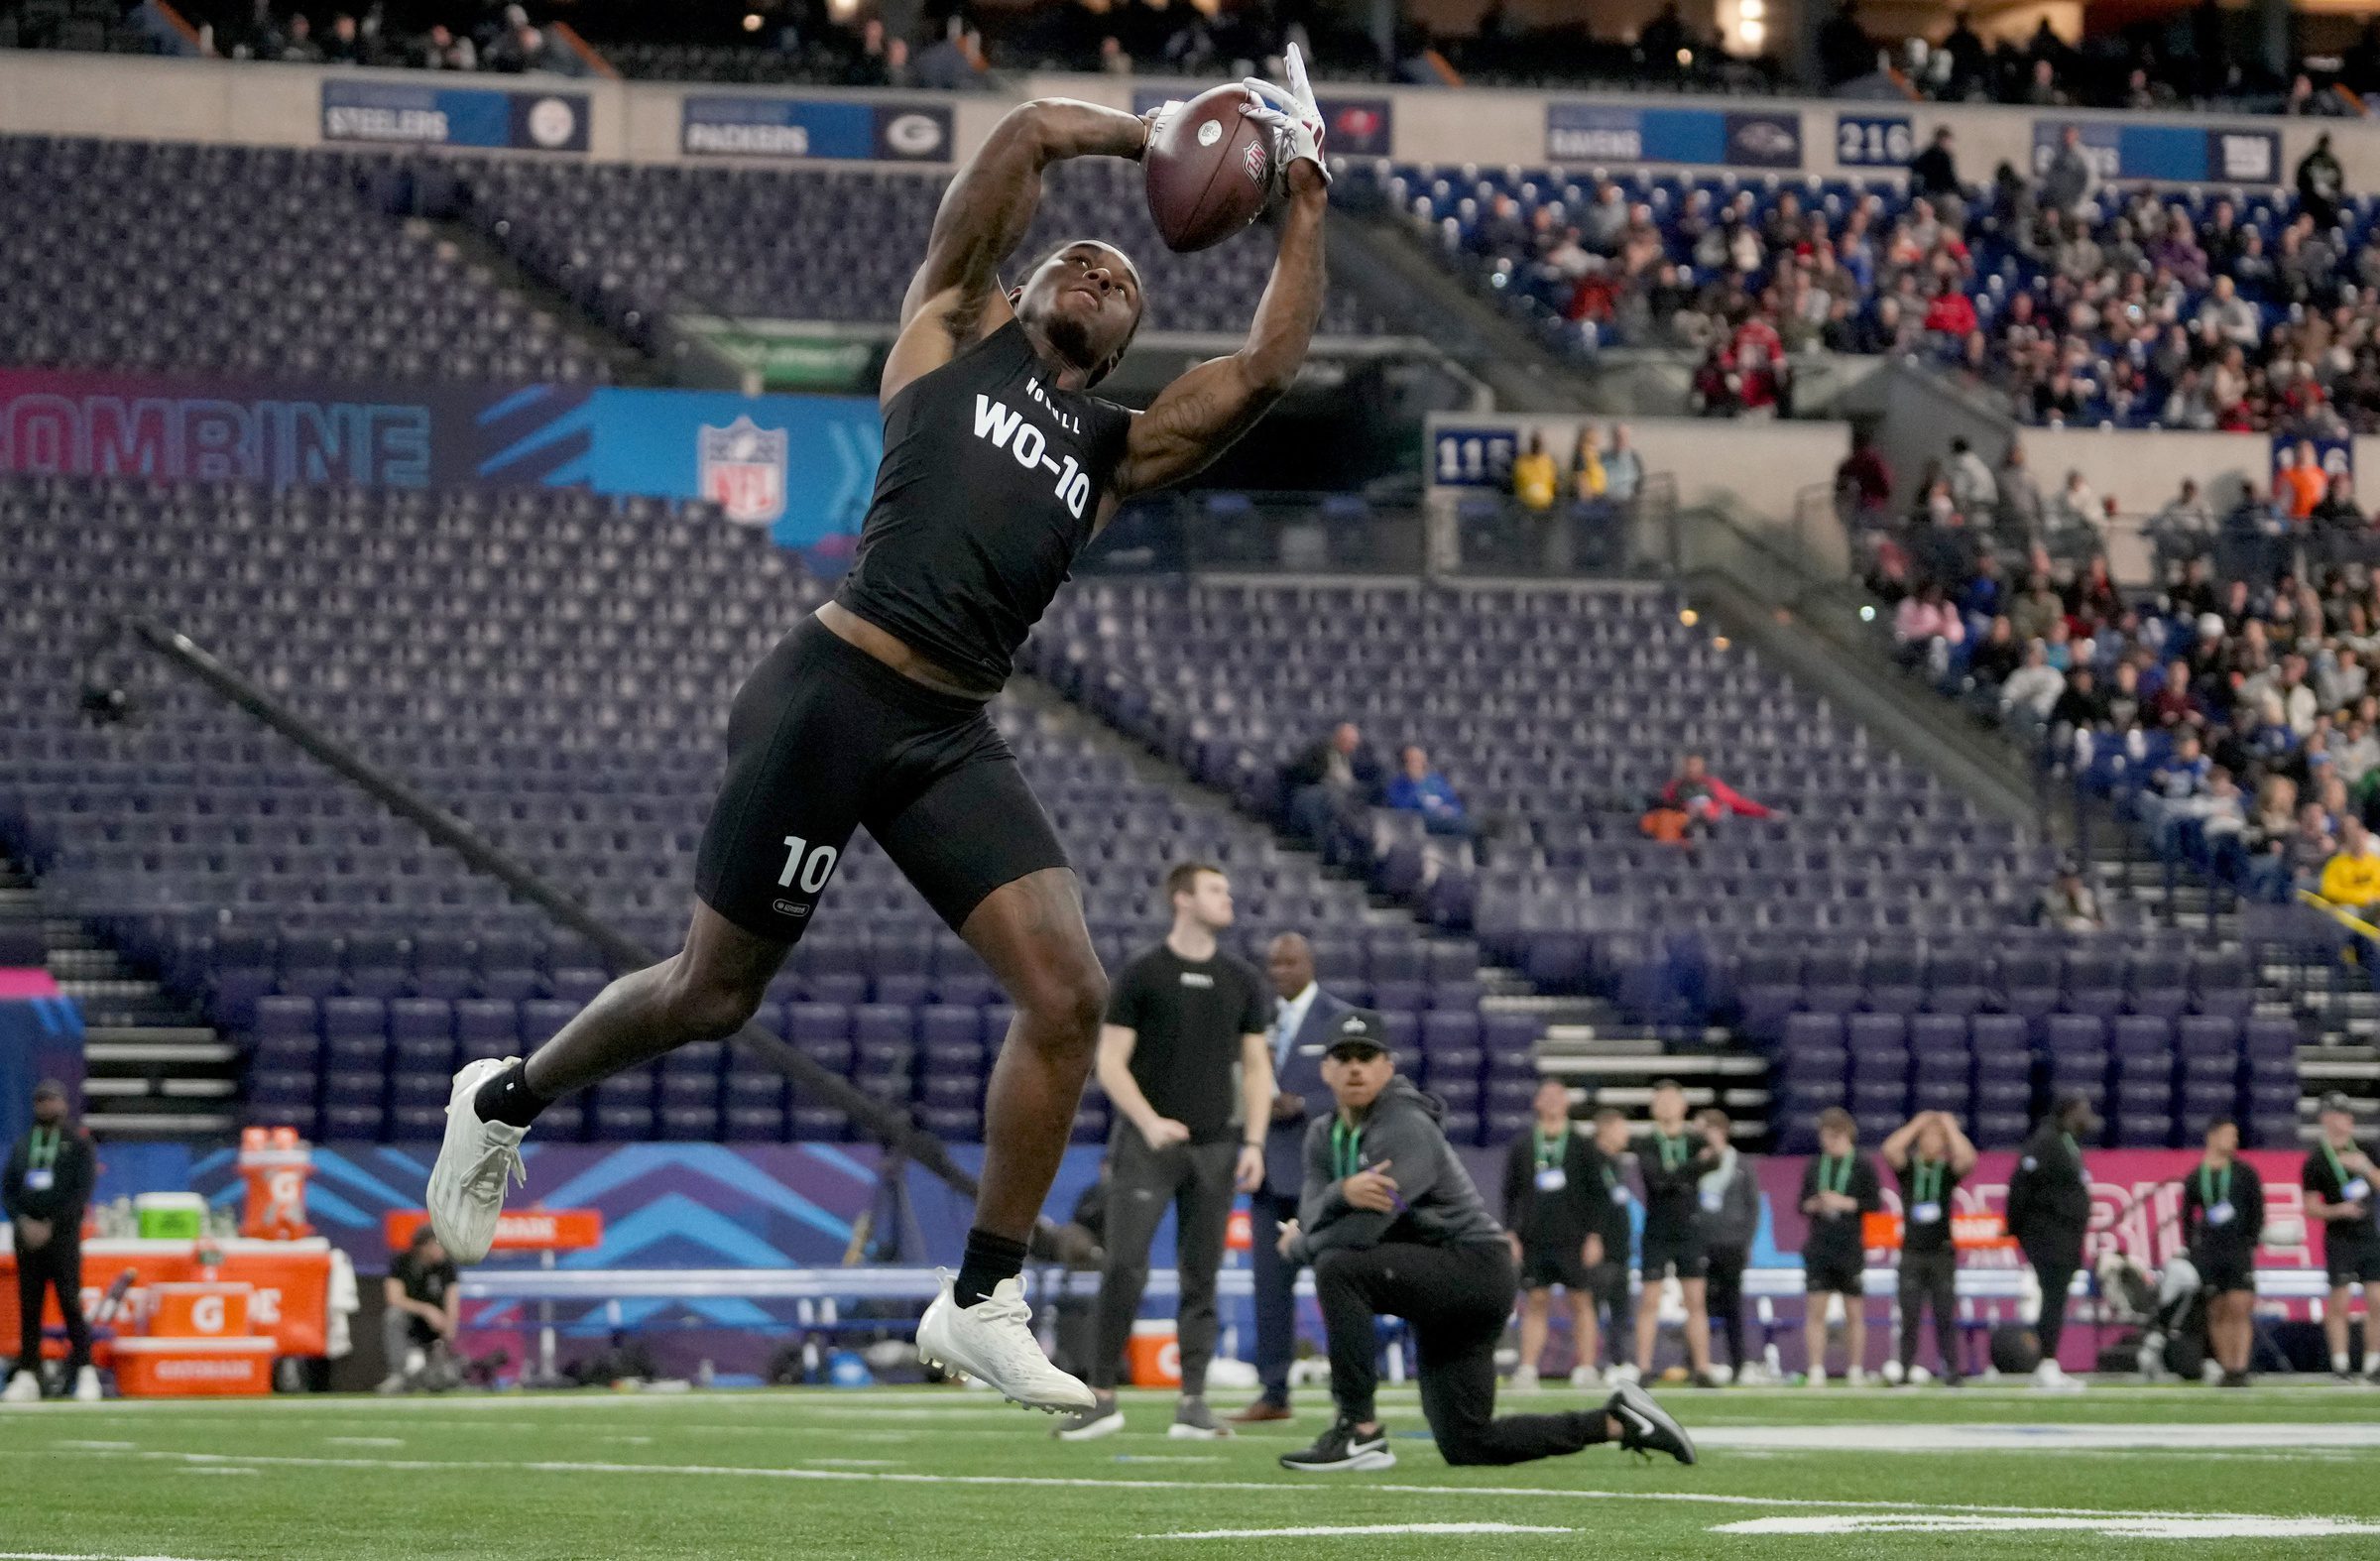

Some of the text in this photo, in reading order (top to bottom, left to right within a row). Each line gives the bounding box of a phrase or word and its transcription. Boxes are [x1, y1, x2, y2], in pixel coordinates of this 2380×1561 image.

[1247, 146, 1265, 175] NFL
[1839, 121, 1910, 163] 216
[0, 394, 430, 488] OMBINE
[974, 394, 1090, 519] WO-10
[777, 835, 838, 894] 10
[191, 1295, 225, 1334] G
